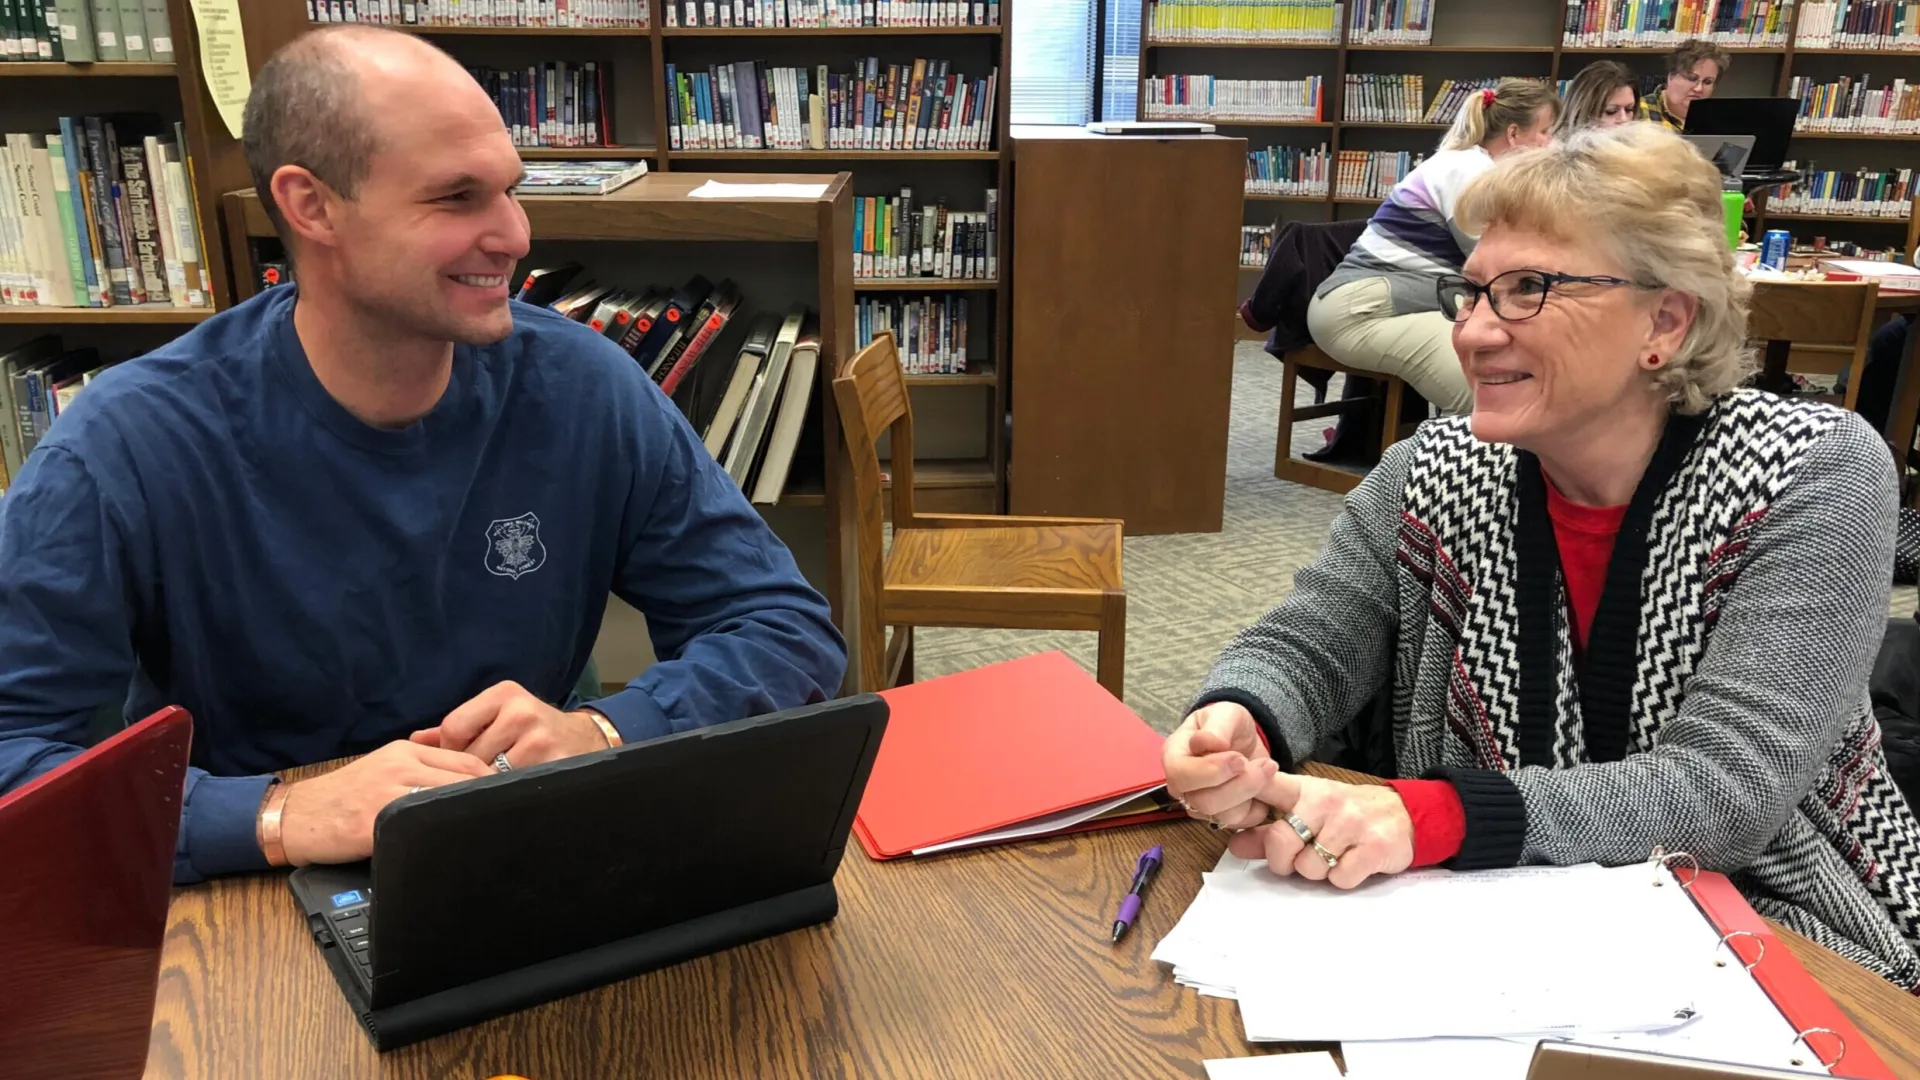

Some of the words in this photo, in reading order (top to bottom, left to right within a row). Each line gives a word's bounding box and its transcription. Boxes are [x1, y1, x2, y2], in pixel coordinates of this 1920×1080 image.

[13, 163, 24, 192] Sunset
[19, 192, 29, 217] Coast
[27, 163, 37, 192] Sunset
[32, 193, 42, 217] Coast
[124, 163, 143, 179] The
[127, 179, 147, 199] San
[130, 198, 151, 240] Francisco
